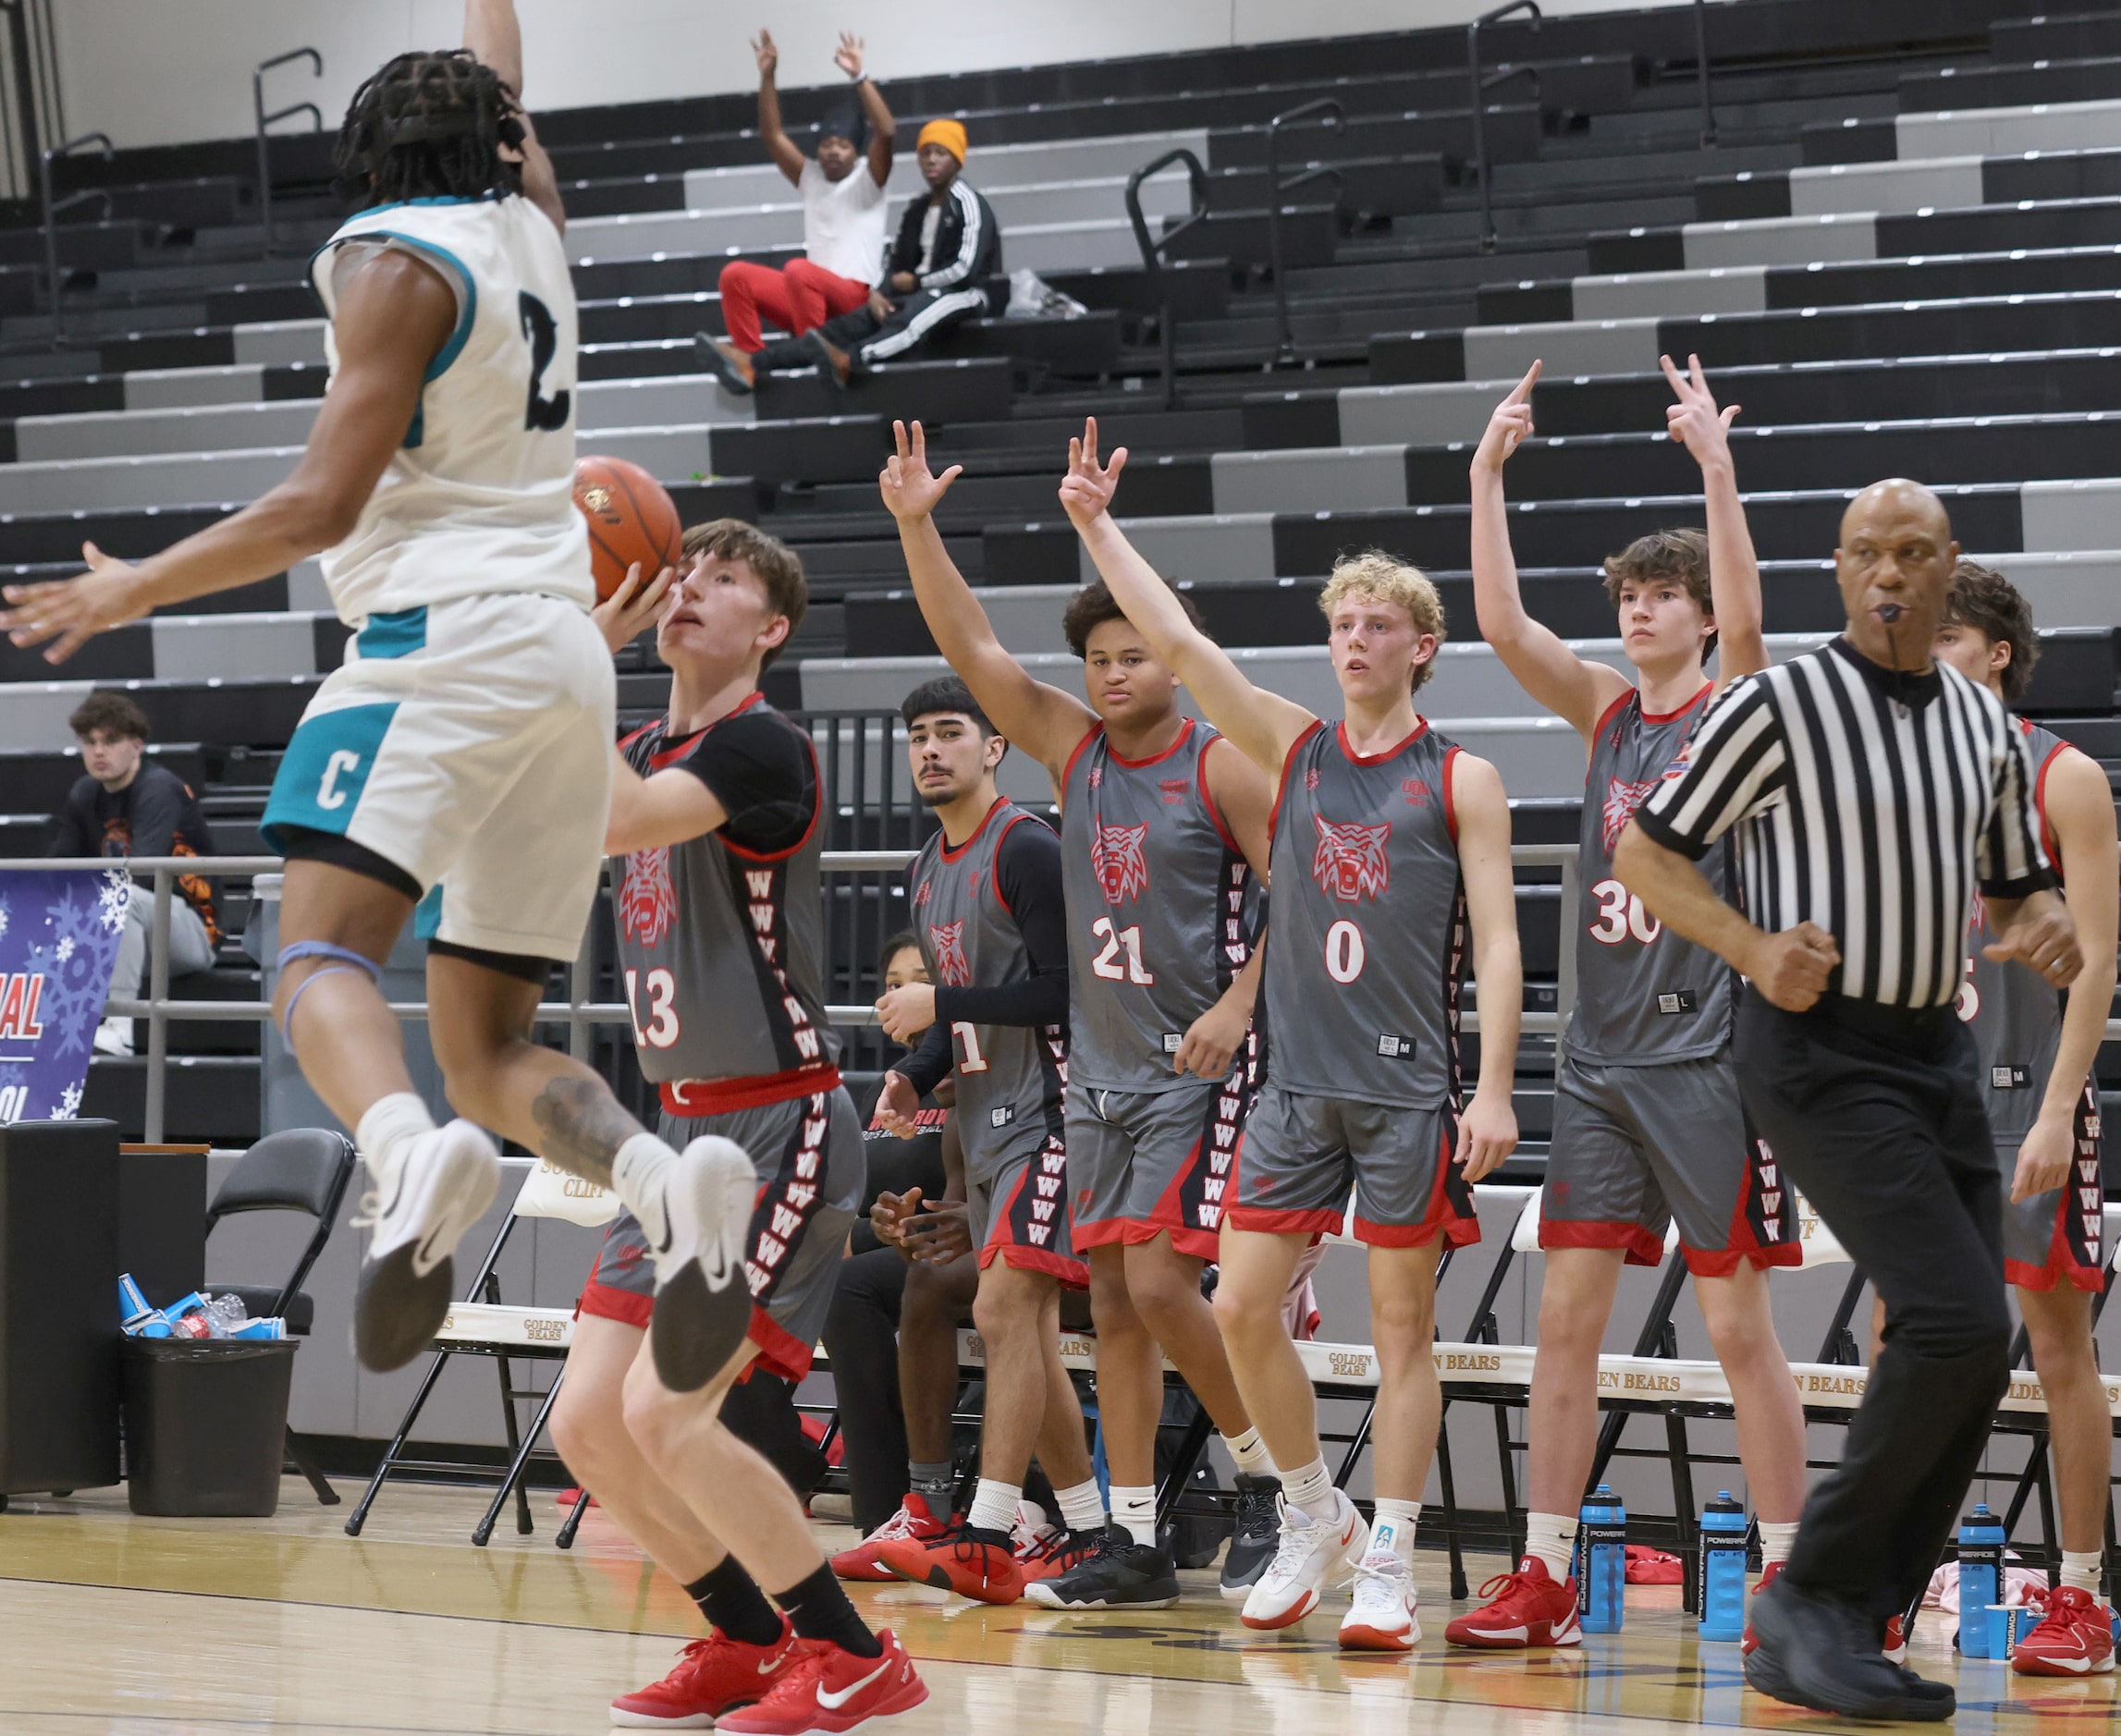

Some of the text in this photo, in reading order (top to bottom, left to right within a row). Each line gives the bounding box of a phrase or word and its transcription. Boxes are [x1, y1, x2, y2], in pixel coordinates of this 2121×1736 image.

[519, 289, 570, 432] 2
[316, 750, 361, 810] C
[744, 870, 773, 899] W
[748, 903, 775, 933] W
[1588, 878, 1663, 945] 30
[1091, 915, 1154, 985] 21
[1324, 918, 1367, 984] 0
[0, 973, 44, 1040] AL
[625, 966, 681, 1050] 13
[1400, 1044, 1410, 1053] M
[2014, 1071, 2024, 1082] M
[1219, 1096, 1241, 1121] W
[1214, 1123, 1236, 1147] W
[1042, 1153, 1065, 1174] W
[1209, 1150, 1232, 1175] W
[2078, 1160, 2098, 1182] W
[1036, 1176, 1060, 1198] W
[1759, 1165, 1776, 1188] W
[1204, 1177, 1226, 1202] W
[2078, 1188, 2100, 1210] W
[1032, 1199, 1056, 1222] W
[1760, 1192, 1782, 1215] W
[771, 1203, 803, 1240] W
[1198, 1204, 1221, 1229] W
[2082, 1214, 2101, 1237] W
[1027, 1223, 1051, 1246] W
[1762, 1218, 1780, 1241] W
[756, 1230, 787, 1268] W
[524, 1319, 567, 1331] GOLDEN
[527, 1330, 561, 1341] BEARS
[1329, 1352, 1372, 1366] GOLDEN
[1332, 1364, 1367, 1376] BEARS
[1446, 1355, 1501, 1371] BEARS
[1624, 1373, 1681, 1392] BEARS
[1808, 1375, 1867, 1397] BEARS
[2008, 1383, 2046, 1400] LDE
[2006, 1610, 2017, 1657] POWERADE
